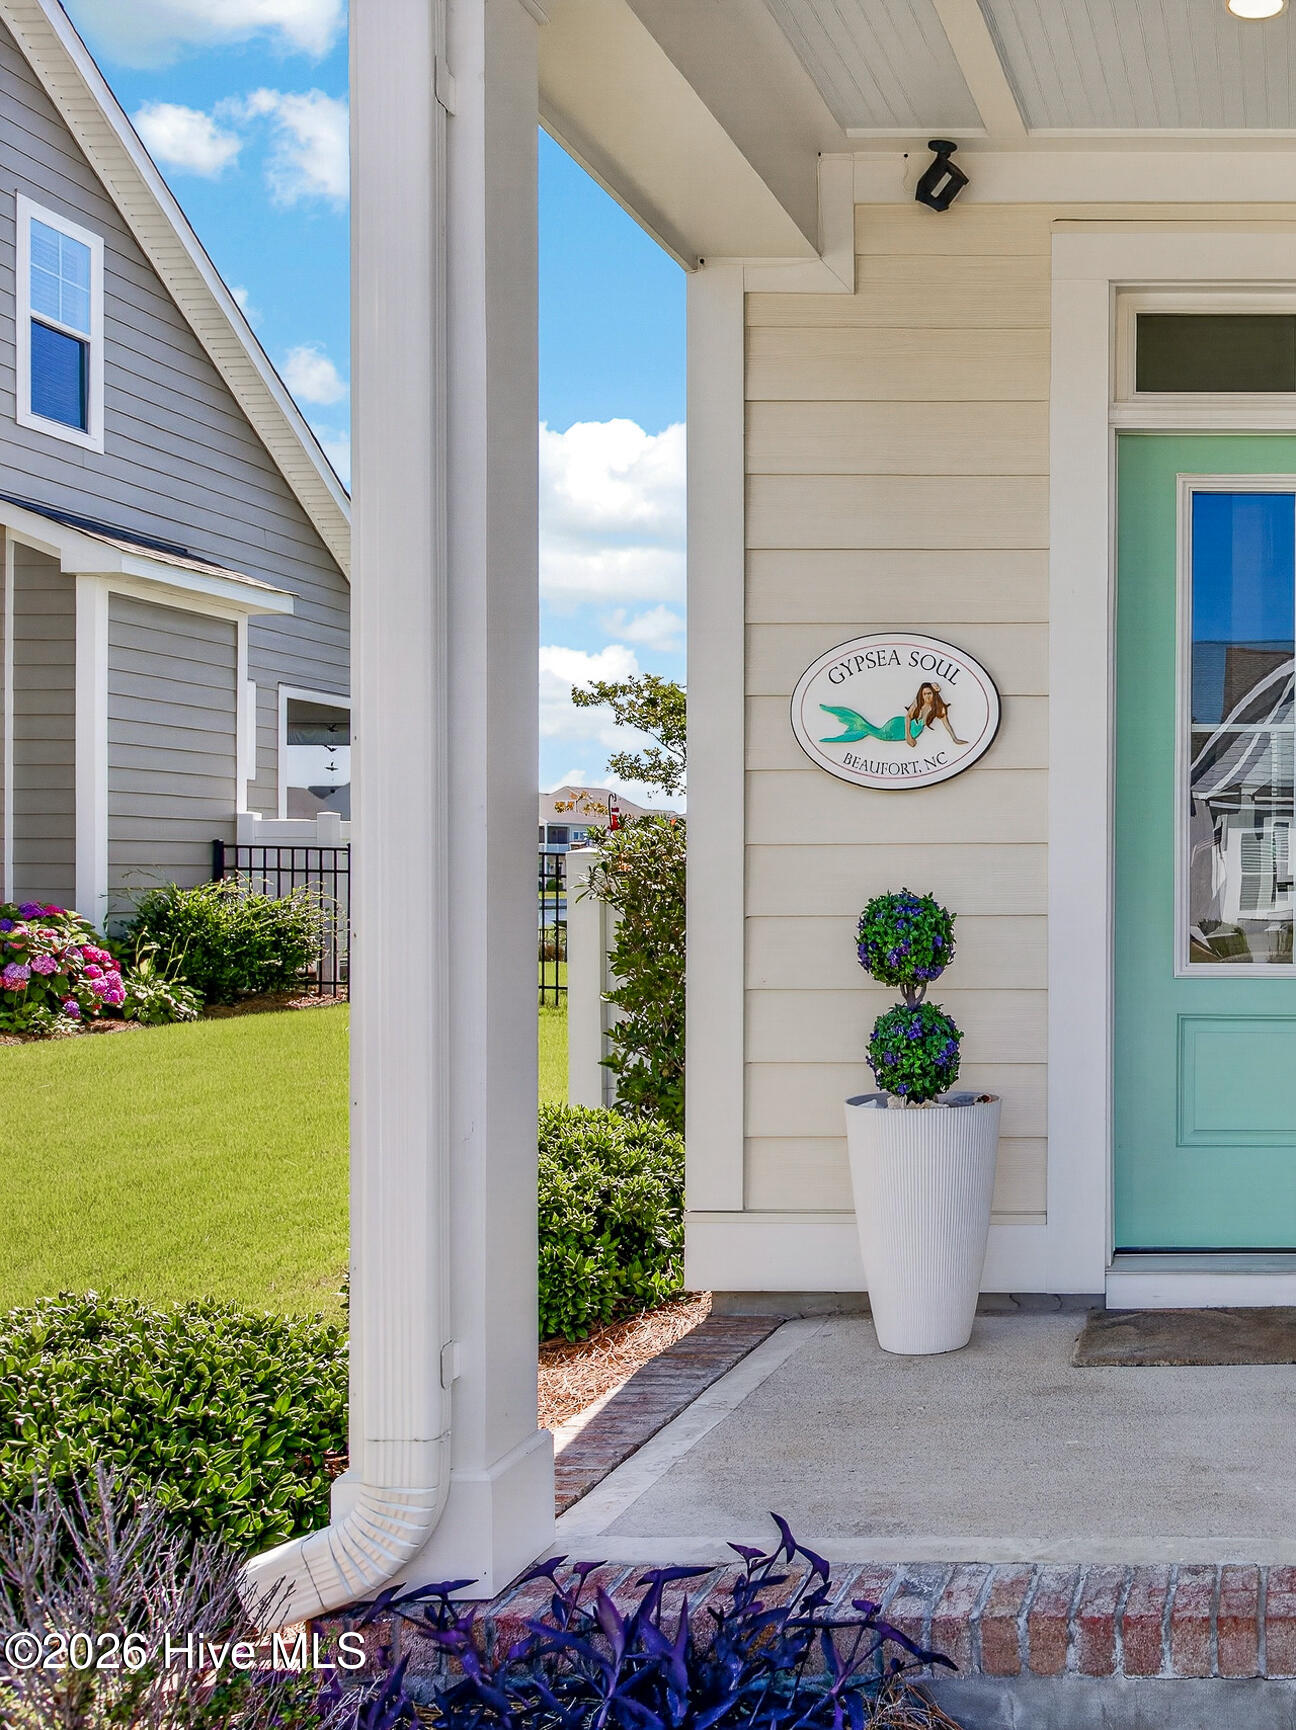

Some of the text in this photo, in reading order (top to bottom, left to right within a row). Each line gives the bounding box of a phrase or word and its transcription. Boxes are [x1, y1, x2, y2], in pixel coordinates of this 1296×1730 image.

[828, 649, 961, 686] GYPSEA SOUL
[924, 752, 949, 771] NC
